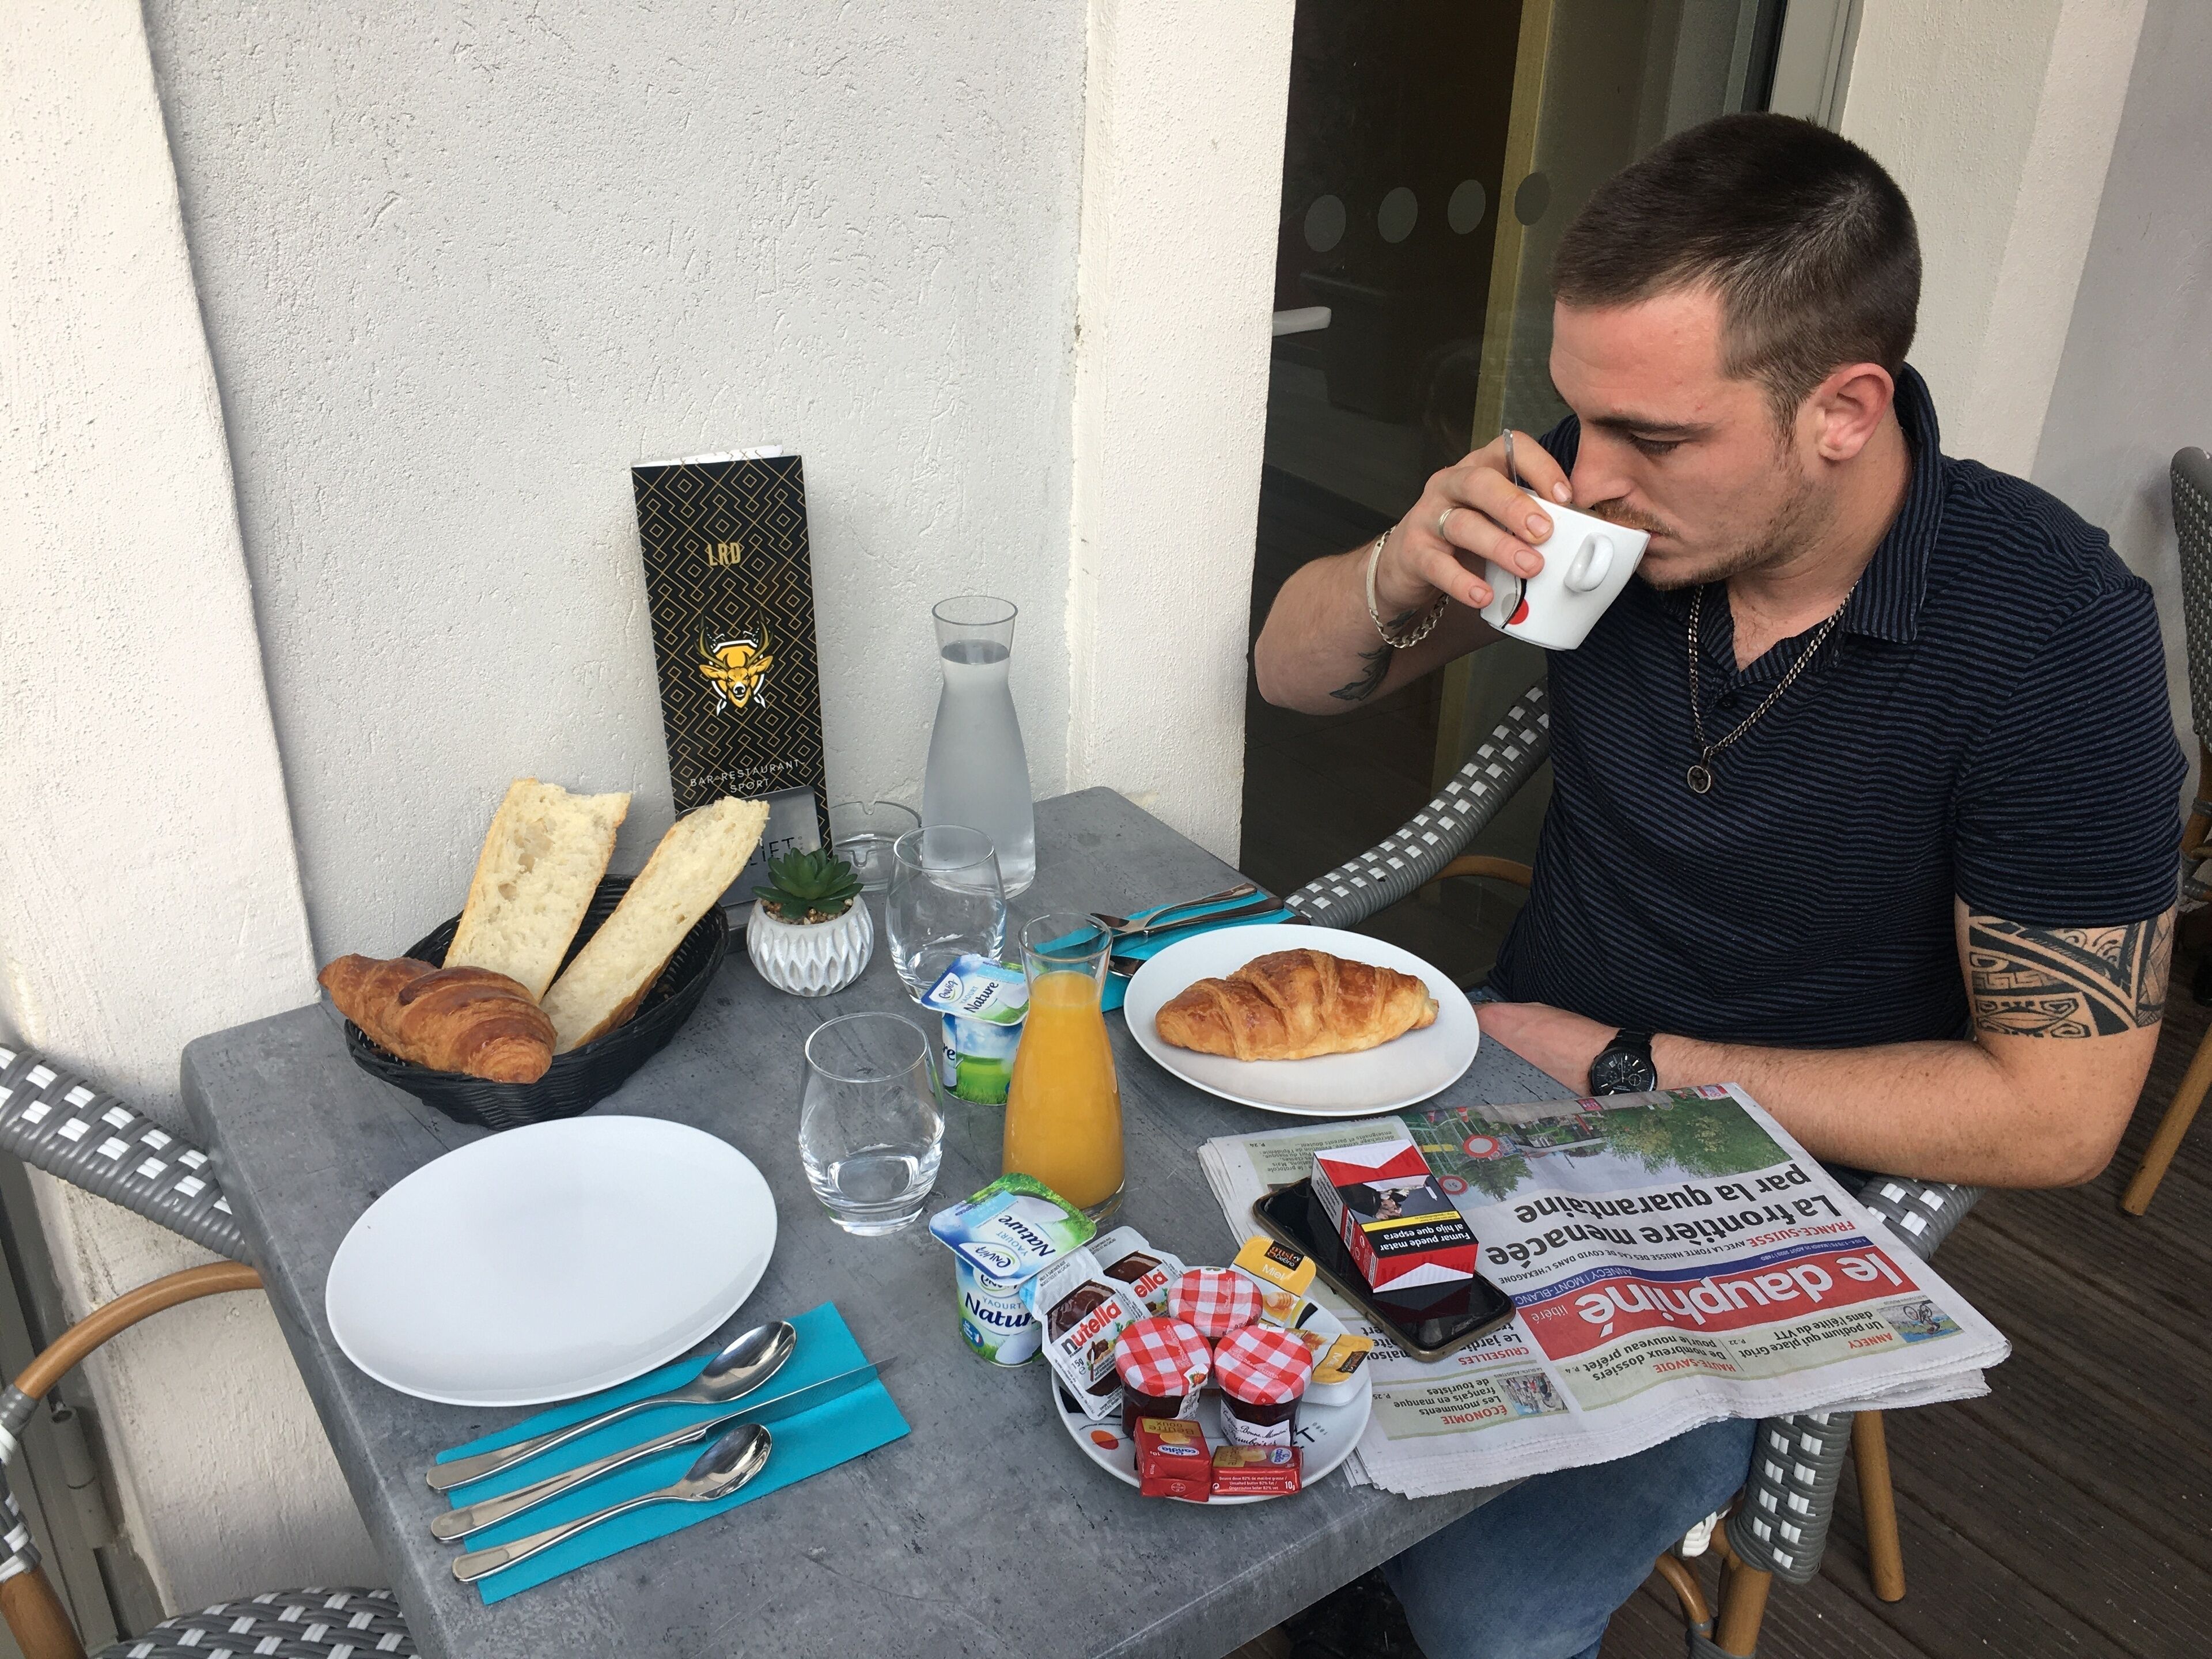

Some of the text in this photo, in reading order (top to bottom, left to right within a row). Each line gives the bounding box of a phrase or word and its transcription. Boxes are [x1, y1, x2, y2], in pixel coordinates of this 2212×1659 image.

[707, 541, 741, 566] LRD
[730, 778, 769, 793] SPORT
[960, 986, 979, 1004] YAOURT
[964, 982, 999, 1013] Nature
[1356, 1131, 1392, 1140] enseignants
[1514, 1164, 1812, 1224] par la quarantaine
[998, 1215, 1056, 1257] Nature
[1383, 1230, 1415, 1240] espera
[1416, 1226, 1434, 1235] que
[1435, 1224, 1454, 1233] hijo
[1485, 1195, 1842, 1269] La frontière menacée
[1746, 1221, 1856, 1248] FRANCE-SUISSE
[996, 1230, 1028, 1256] YAOURT
[1380, 1232, 1471, 1251] Fumar puede matar
[1726, 1240, 1745, 1251] AVEC
[1577, 1250, 1604, 1259] COVID
[1651, 1252, 1683, 1260] HAUSSE
[1684, 1248, 1710, 1256] FORTE
[1552, 1255, 1576, 1269] DANS
[1262, 1264, 1285, 1281] Miel
[1498, 1266, 1550, 1284] L'HEXAGONE
[1134, 1271, 1169, 1298] ella
[1514, 1267, 1632, 1305] ANNECY MONT-BLANC
[983, 1296, 1022, 1310] YAOURT
[1530, 1253, 1903, 1338] le dauphiné libéré
[965, 1292, 1033, 1328] Natur
[1060, 1301, 1122, 1355] nutella
[1773, 1310, 1873, 1340] dans l'élite du VTT
[1503, 1334, 1522, 1343] Le
[1737, 1320, 1884, 1358] Un podium qui place Griot
[1847, 1332, 1893, 1349] ANNECY
[1457, 1346, 1530, 1366] CRUSEILLES
[1582, 1335, 1717, 1373] pour le nouveau préfet
[1071, 1358, 1084, 1369] 15g
[1592, 1345, 1727, 1382] De nombreux dossiers
[1652, 1358, 1737, 1374] HAUTE-SAVOIE
[1426, 1378, 1490, 1396] de touristes
[1393, 1387, 1496, 1409] français en manque
[1418, 1395, 1502, 1416] Les monuments
[1440, 1404, 1508, 1425] ÉCONOMIE
[1240, 1425, 1262, 1438] Bonne
[1285, 1480, 1296, 1491] 10g
